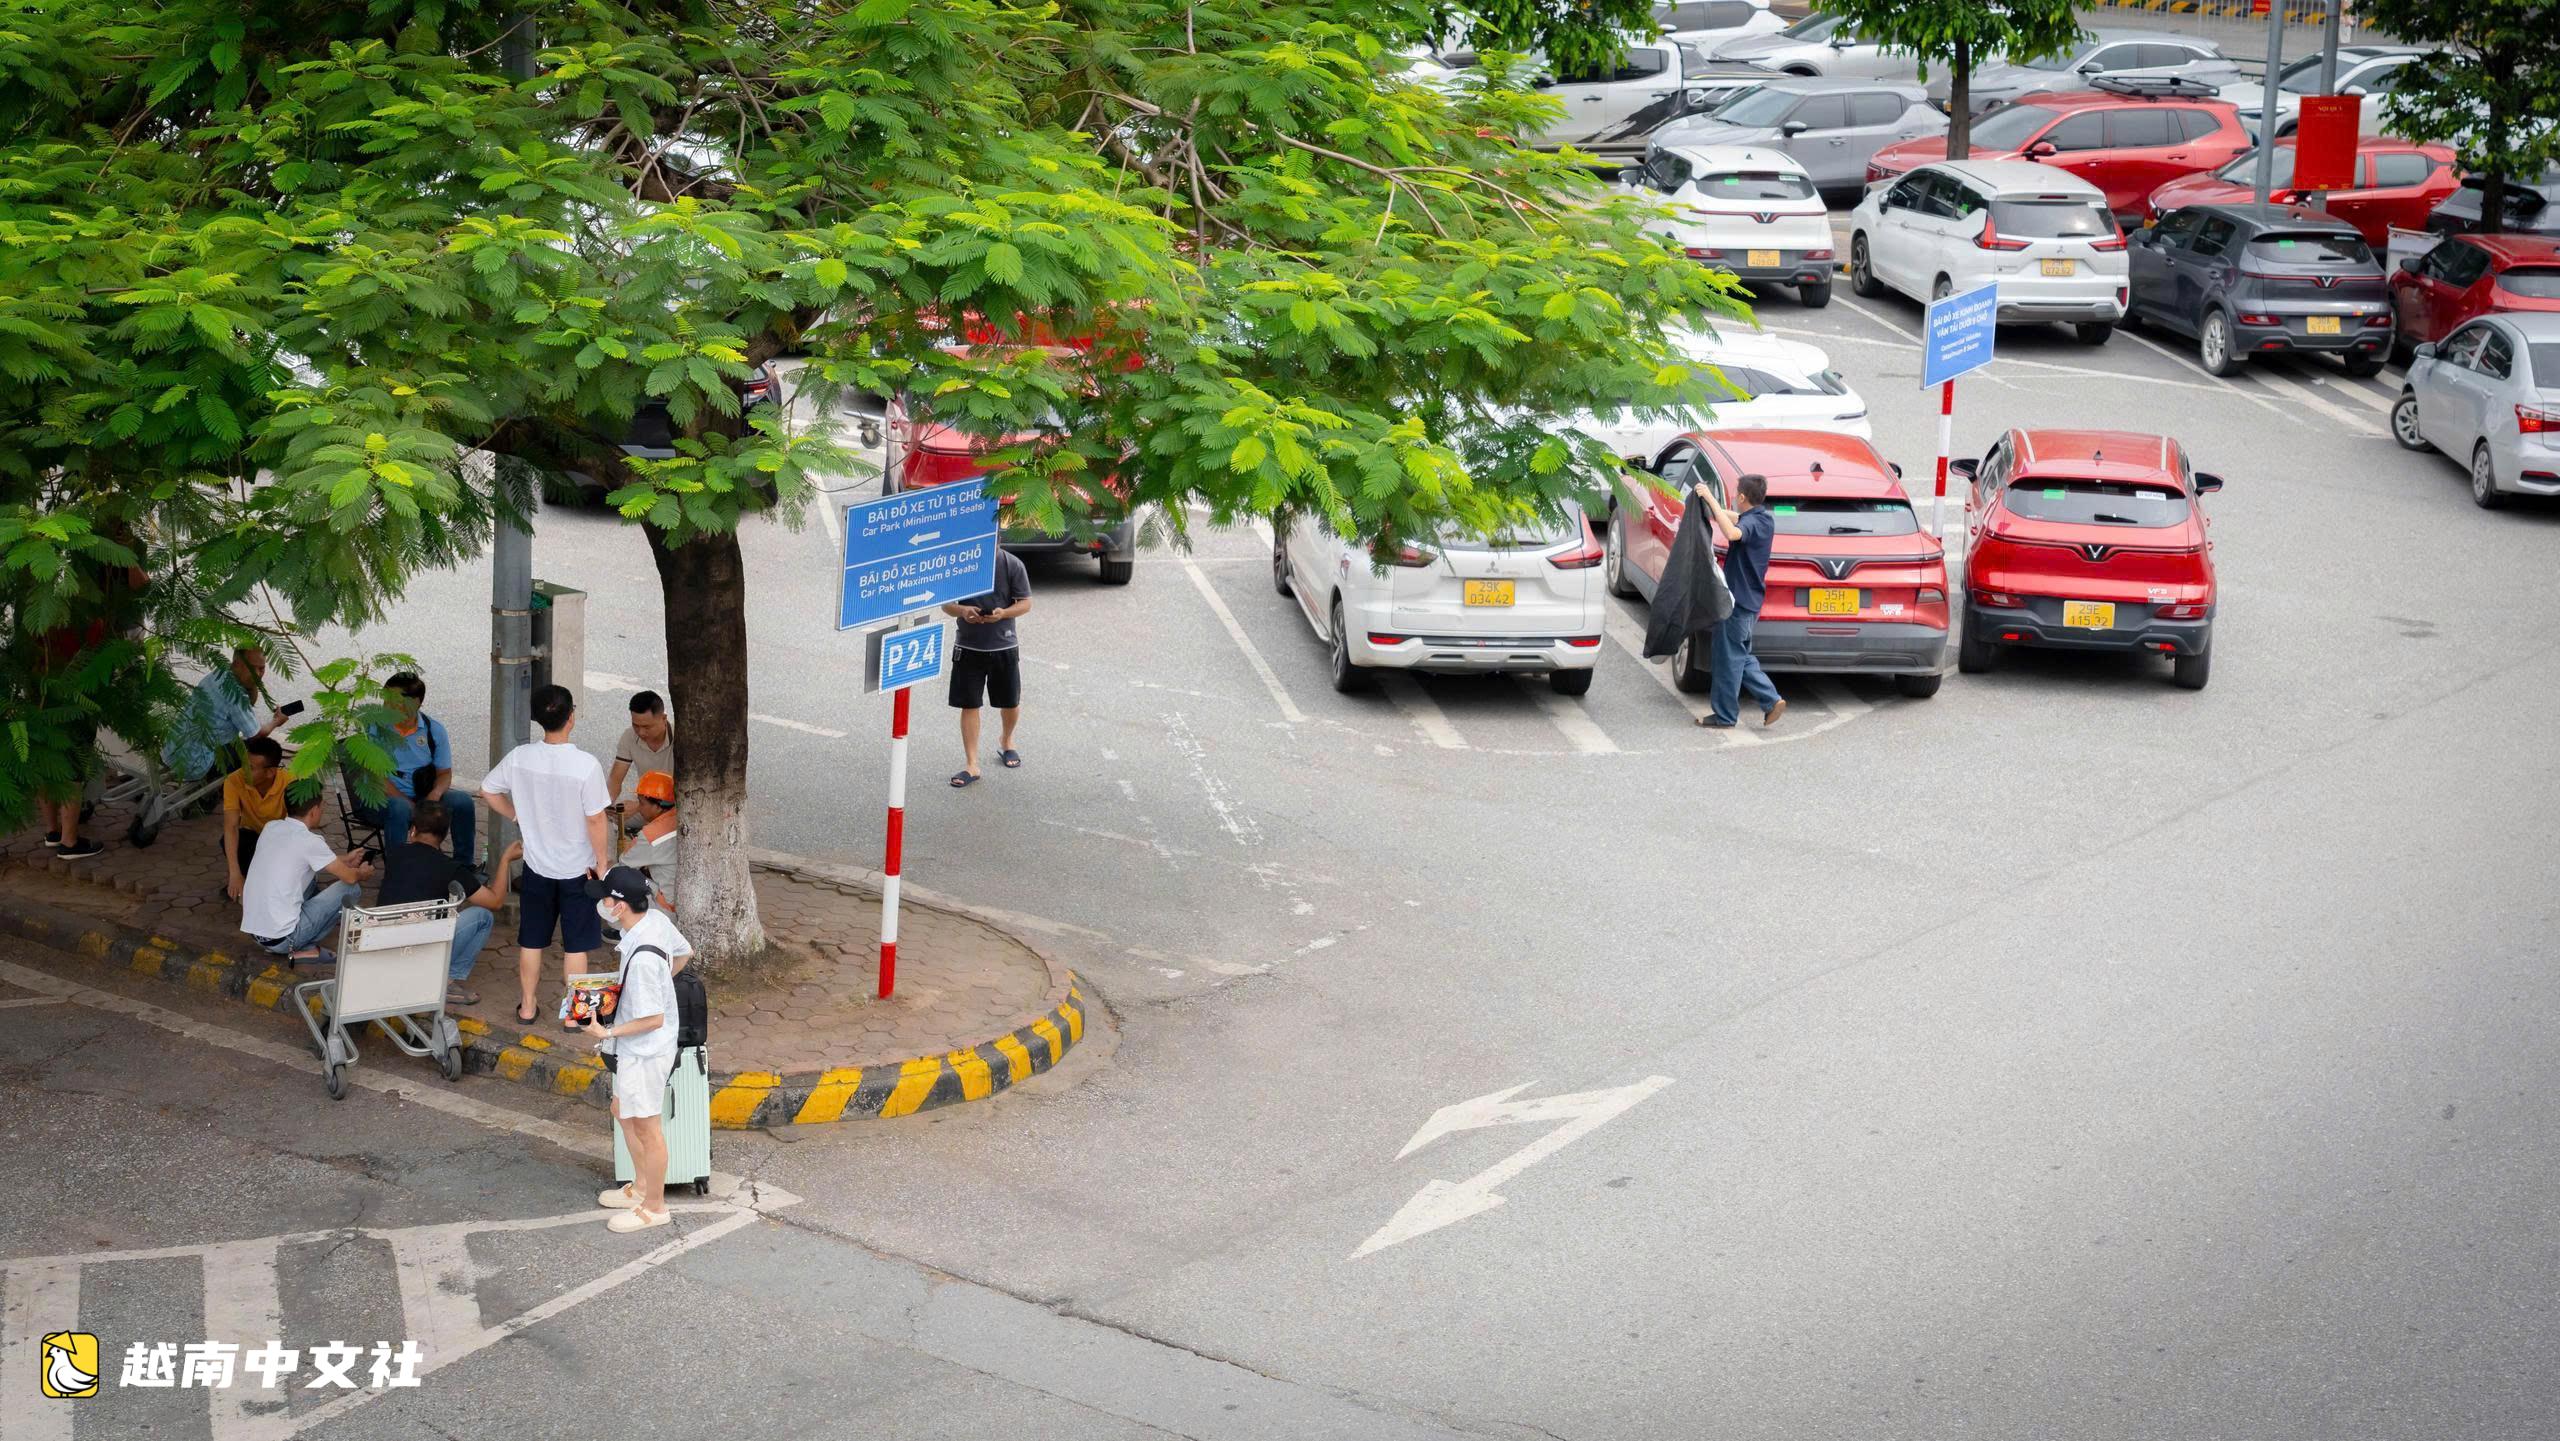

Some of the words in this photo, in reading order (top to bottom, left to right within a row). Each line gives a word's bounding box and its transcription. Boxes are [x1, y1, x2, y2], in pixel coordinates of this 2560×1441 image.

[867, 507, 888, 524] BÃI
[890, 500, 907, 519] ĐỖ
[910, 501, 925, 514] XE
[928, 495, 943, 510] TỪ
[946, 495, 956, 506] 16
[959, 483, 982, 503] CHỖ
[862, 527, 878, 537] Car
[880, 521, 901, 534] Park
[902, 511, 947, 529] (Minimum
[950, 508, 958, 517] 16
[960, 502, 985, 515] Seats)
[859, 571, 879, 587] BÃI
[881, 563, 898, 582] ĐỖ
[901, 563, 917, 577] XE
[919, 553, 947, 573] DƯỚI
[949, 554, 956, 565] 9
[958, 543, 982, 563] CHỖ
[860, 588, 876, 599] Car
[878, 583, 895, 595] Pak
[897, 572, 943, 591] (Maximum
[945, 568, 951, 578] 8
[952, 562, 978, 576] Seats)
[1479, 582, 1500, 592] 29K
[1470, 594, 1509, 605] 034.42
[1824, 590, 1845, 600] 35H
[1815, 602, 1853, 612] 096.12
[2079, 604, 2100, 615] 29E
[2071, 615, 2108, 627] 115.32
[888, 633, 936, 677] P24
